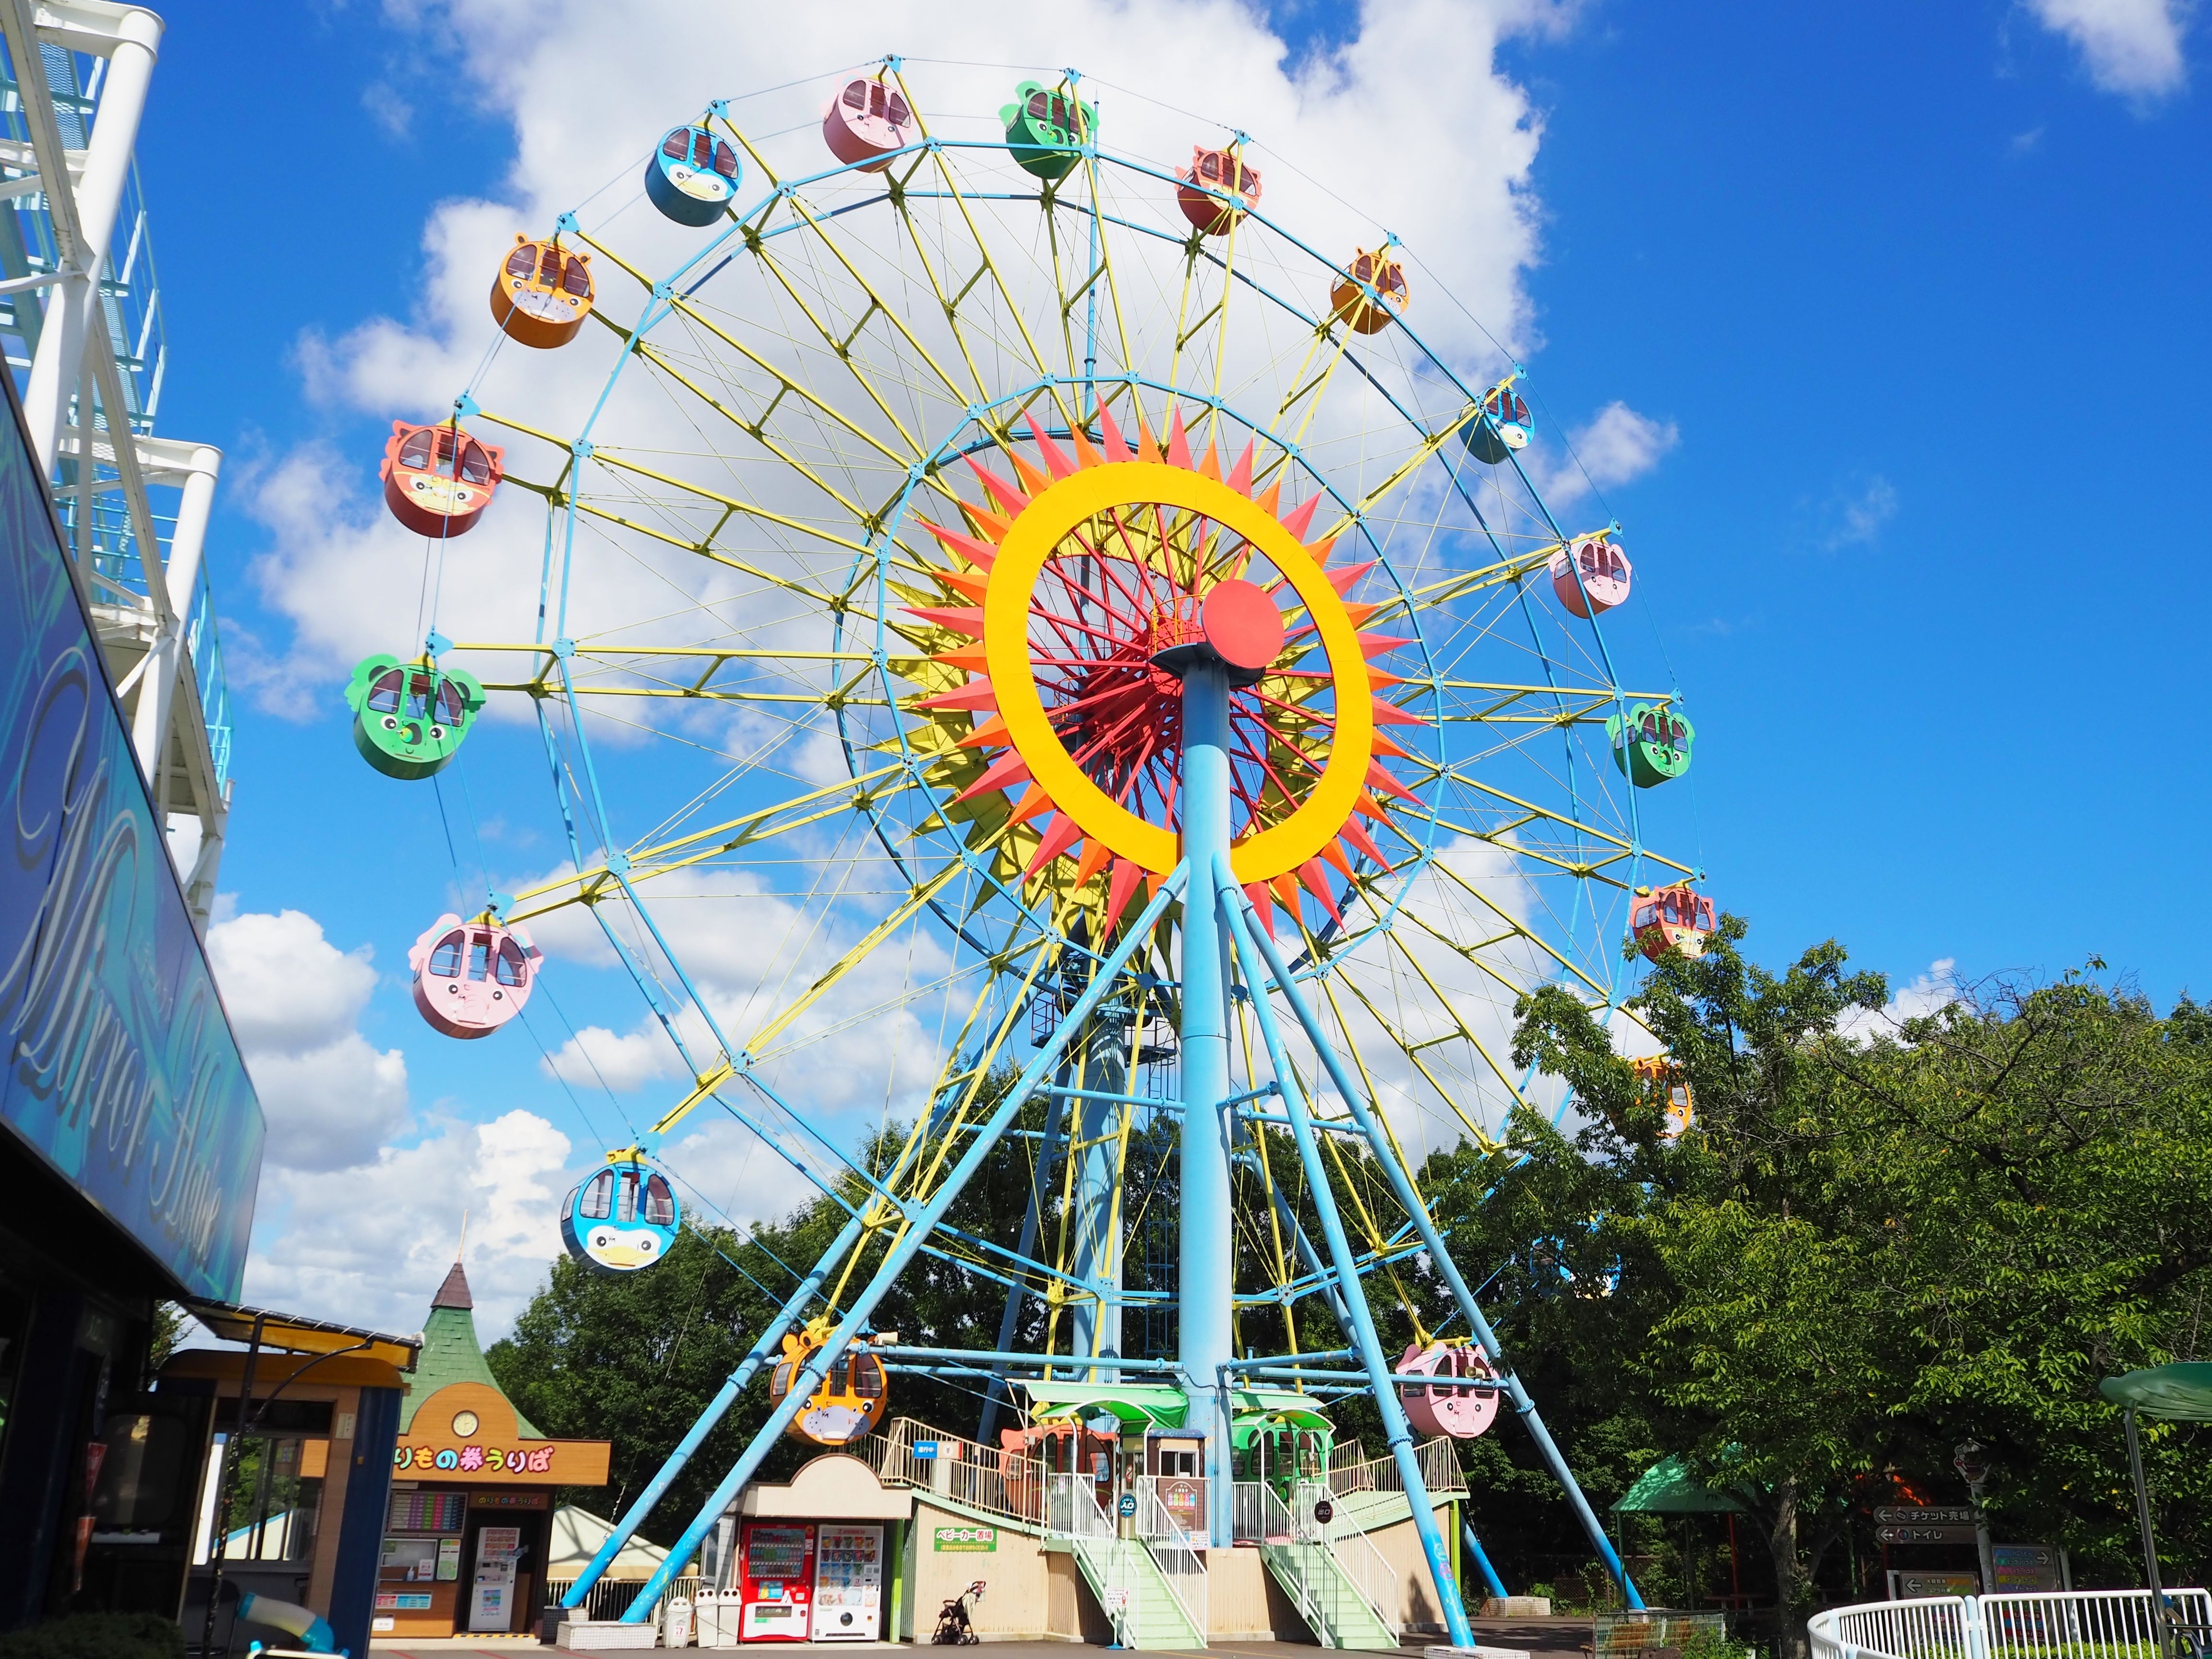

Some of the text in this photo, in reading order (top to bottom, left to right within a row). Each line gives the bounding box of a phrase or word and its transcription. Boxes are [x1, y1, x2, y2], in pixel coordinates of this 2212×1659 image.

[0, 646, 156, 1167] Mirror
[479, 1496, 539, 1506] のりもの券うりば
[1911, 1511, 1970, 1521] チケット売場
[938, 1530, 993, 1540] ベビーカー置場
[1912, 1529, 1943, 1540] トイレ
